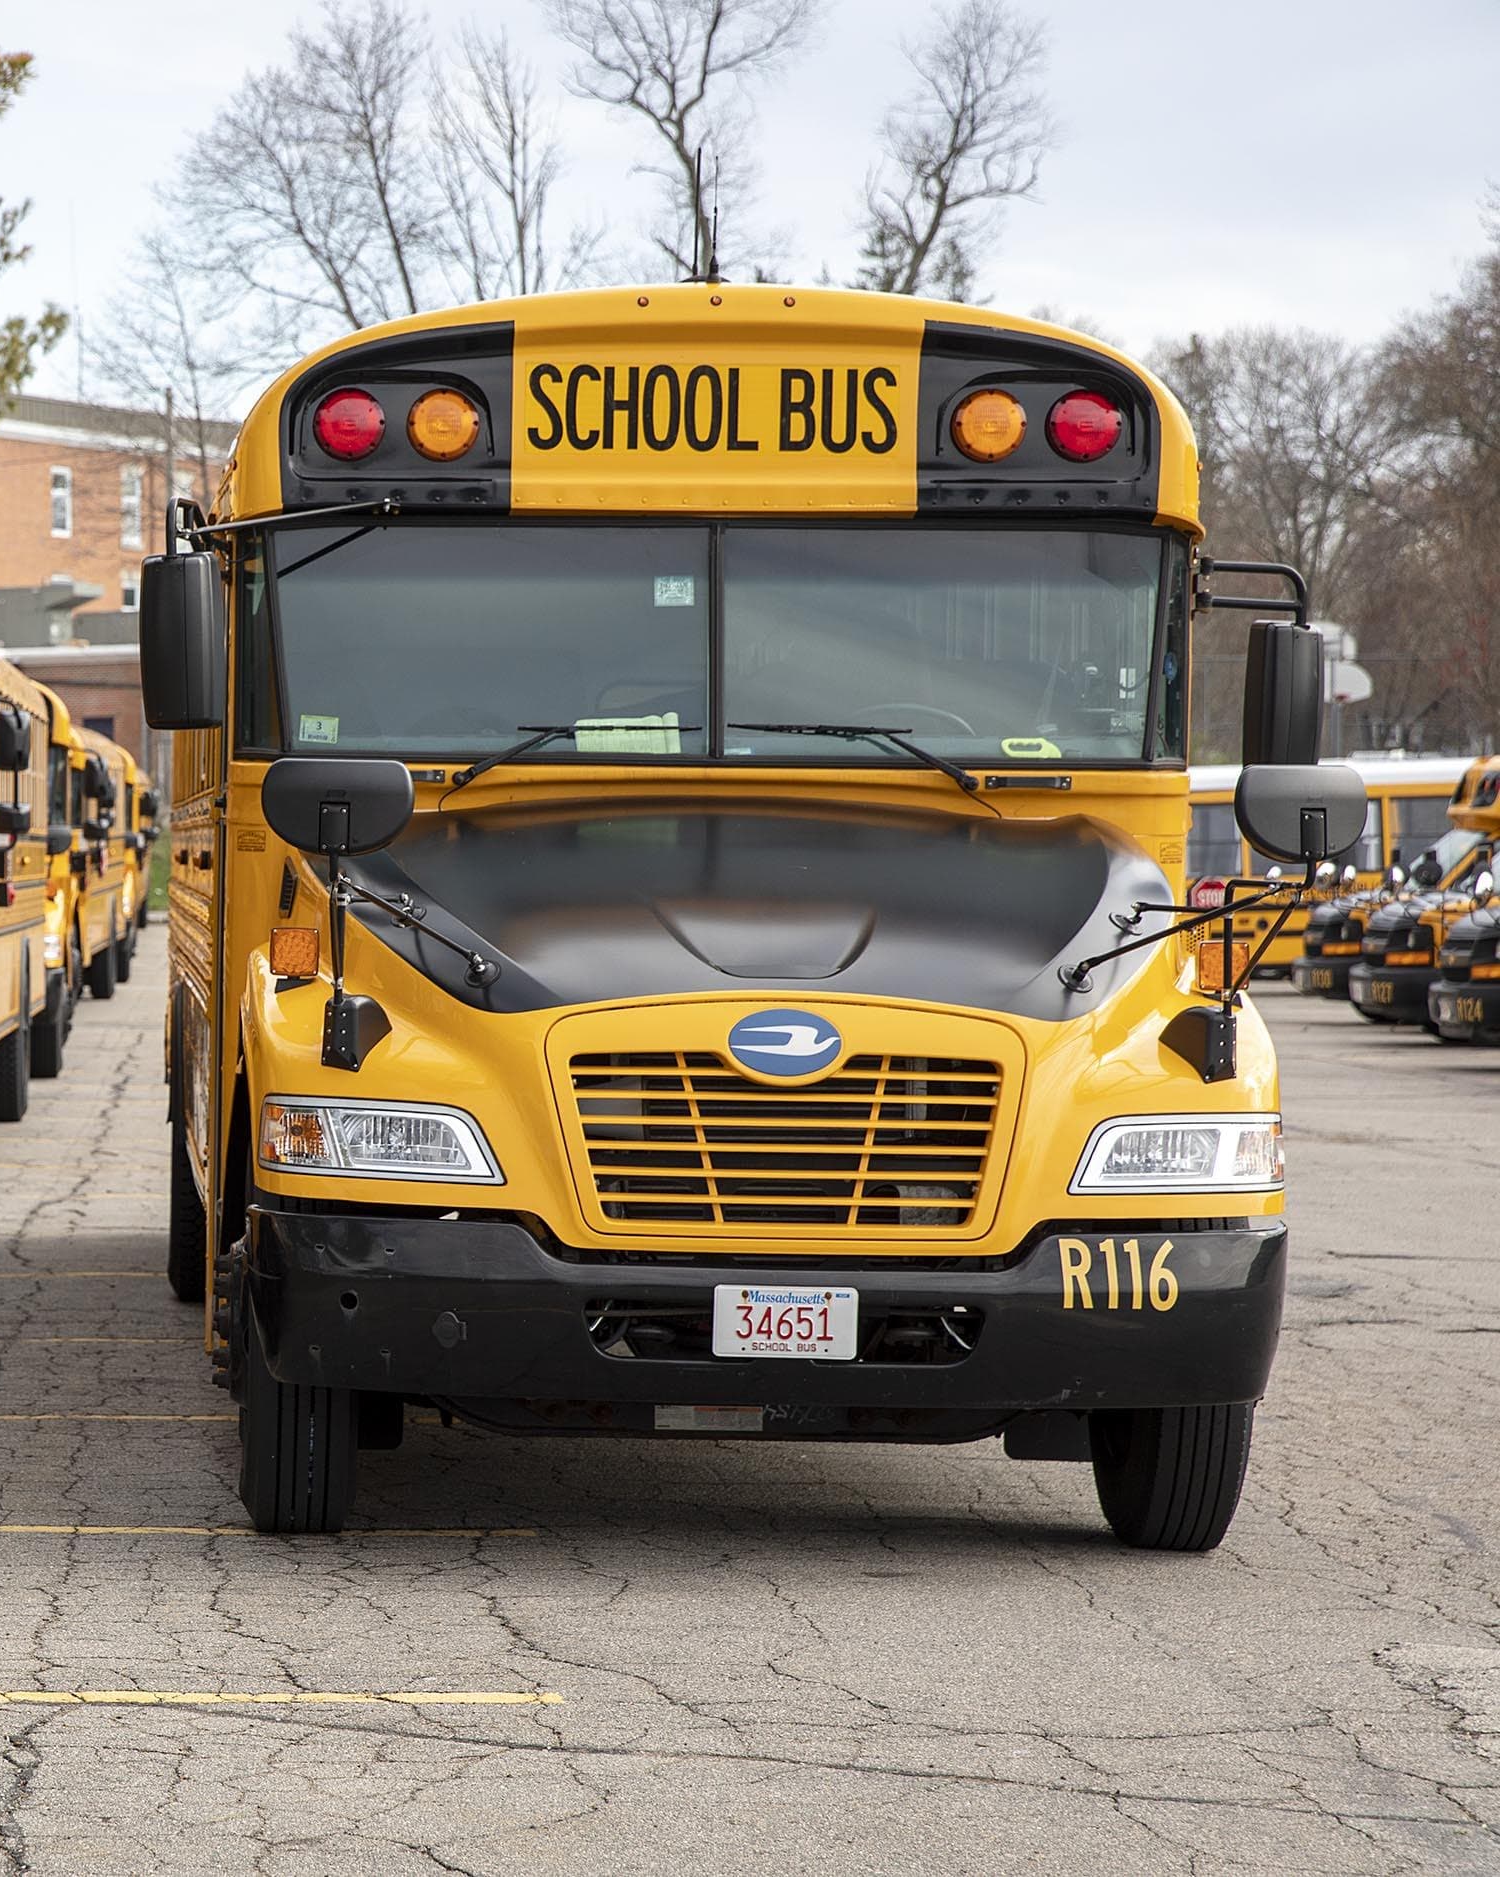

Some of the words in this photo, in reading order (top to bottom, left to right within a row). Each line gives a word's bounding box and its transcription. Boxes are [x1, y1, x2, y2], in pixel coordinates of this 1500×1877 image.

[527, 363, 759, 452] SCHOOL
[779, 367, 898, 454] BUS
[316, 721, 322, 731] 3
[1456, 997, 1483, 1022] R124
[1058, 1238, 1179, 1312] R116
[748, 1290, 826, 1305] Massachusetts
[736, 1305, 834, 1341] 34651
[751, 1342, 792, 1352] SCHOOL
[797, 1343, 817, 1353] BUS
